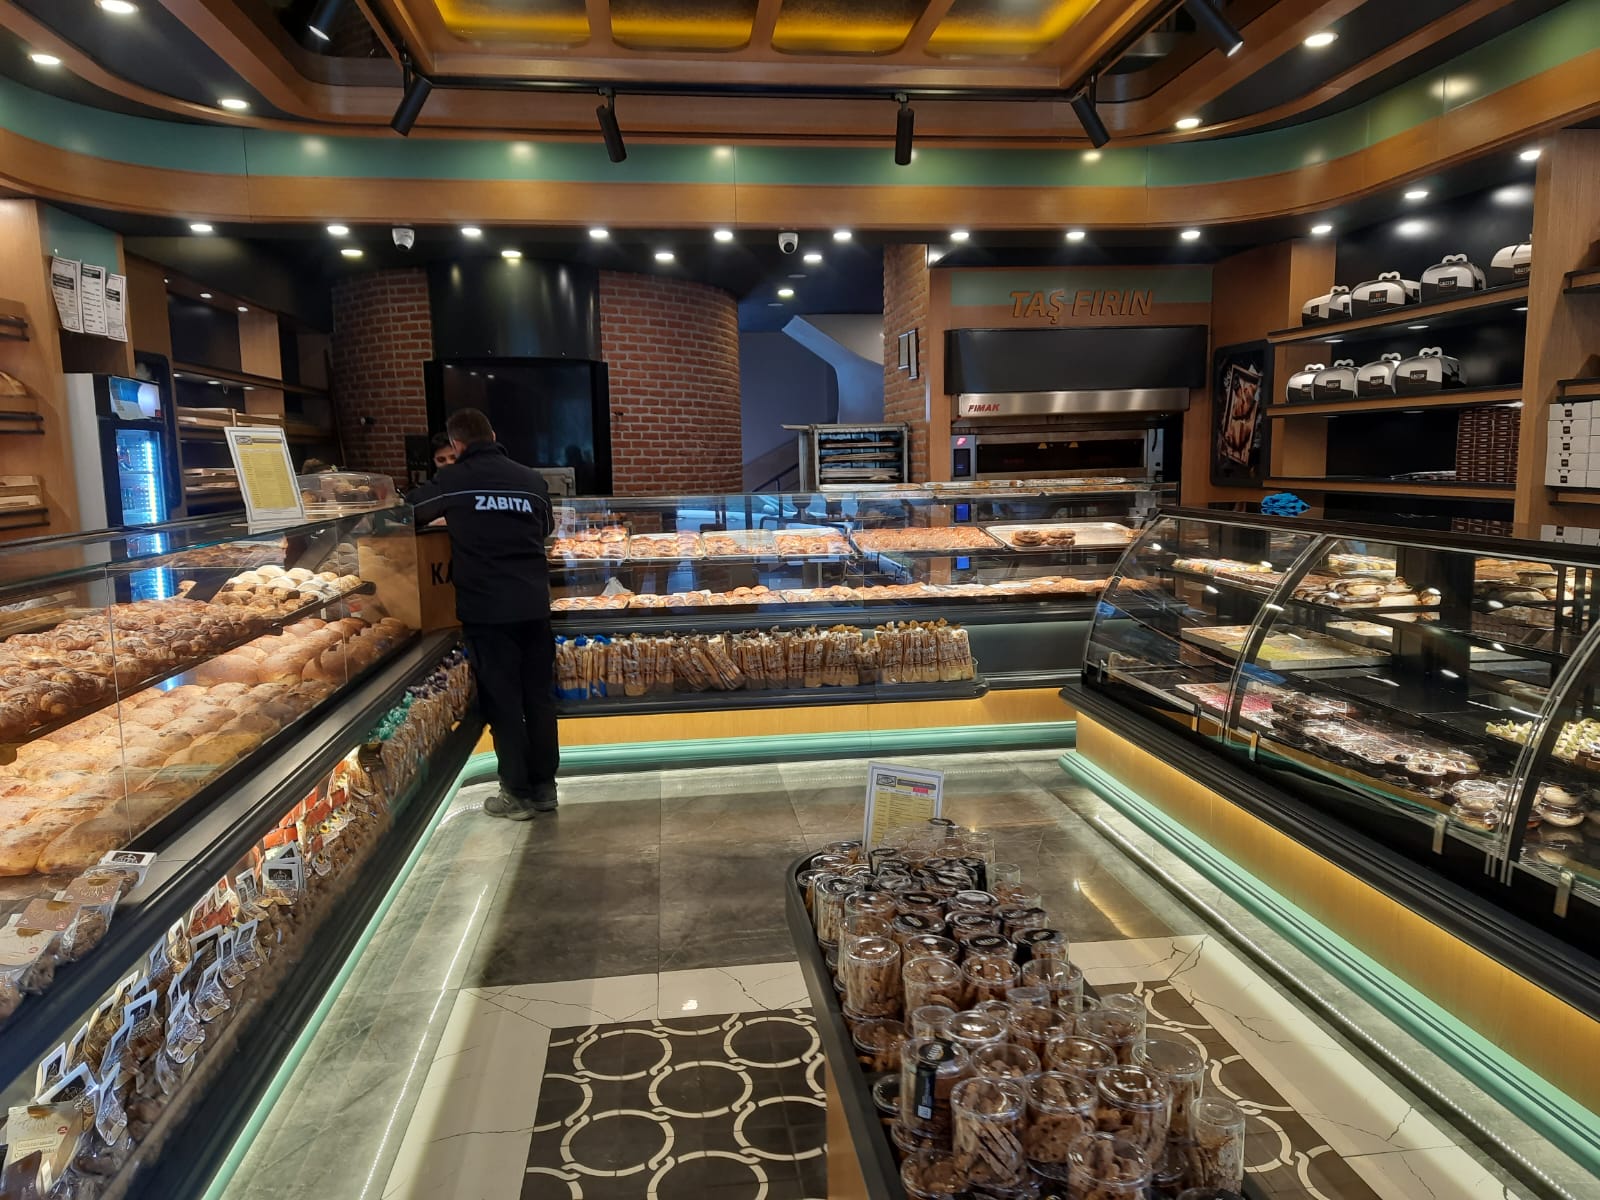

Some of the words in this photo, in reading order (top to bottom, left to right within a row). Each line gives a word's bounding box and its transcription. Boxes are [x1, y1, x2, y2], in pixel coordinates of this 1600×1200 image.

[1011, 291, 1065, 325] TAŞ
[1072, 290, 1154, 317] FIRIN
[968, 403, 1000, 413] FIMAK
[474, 495, 533, 513] ZABITA
